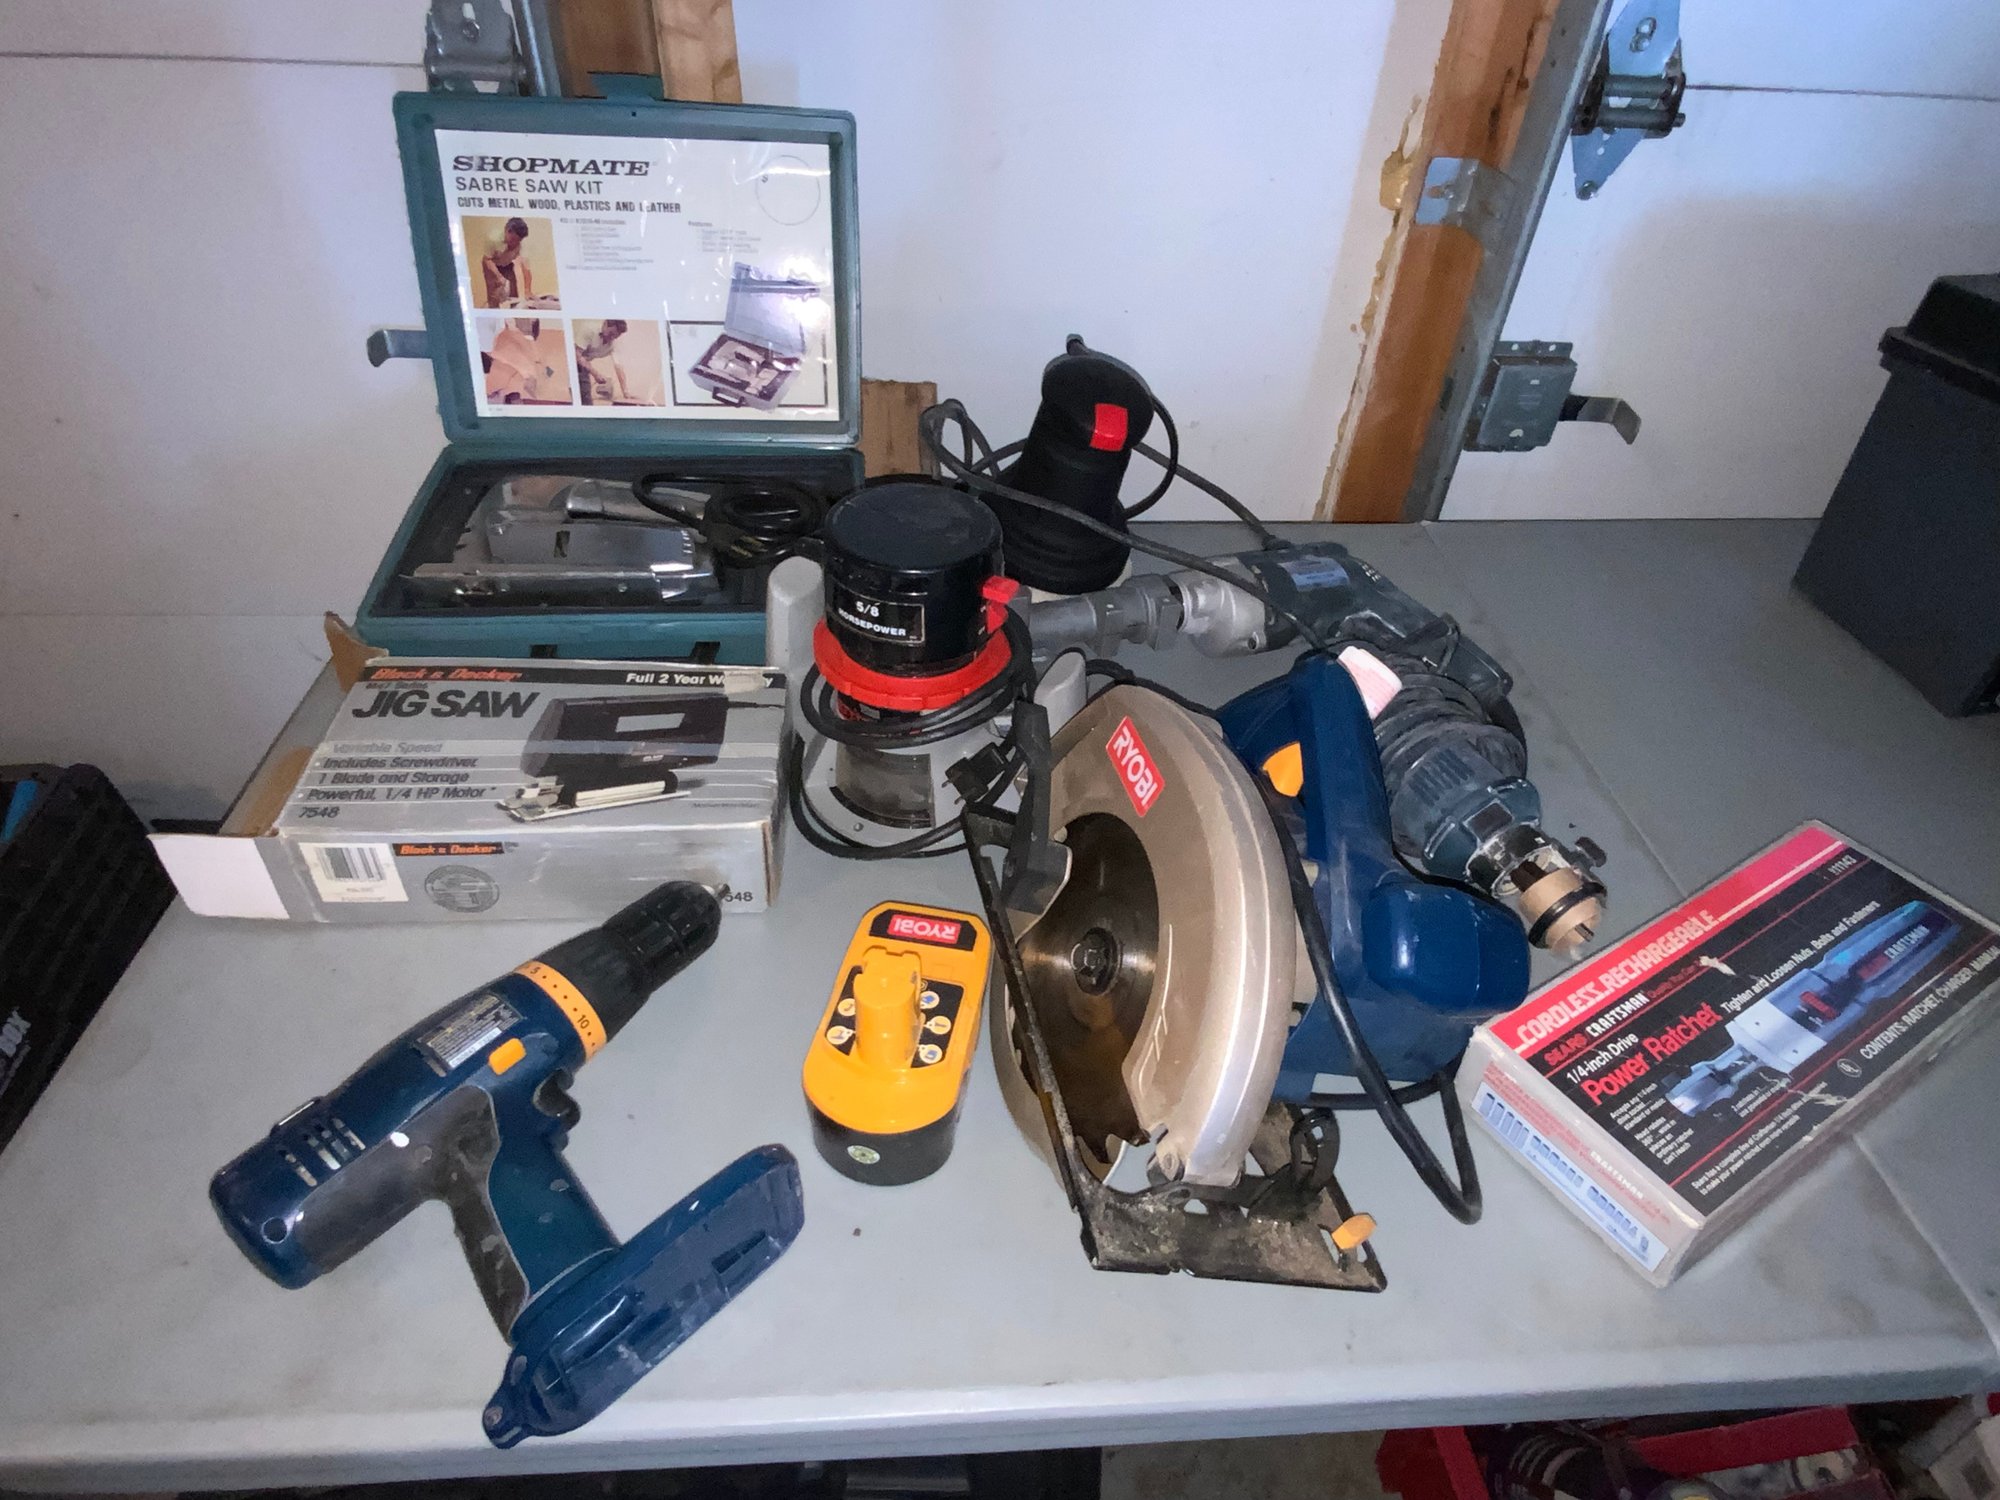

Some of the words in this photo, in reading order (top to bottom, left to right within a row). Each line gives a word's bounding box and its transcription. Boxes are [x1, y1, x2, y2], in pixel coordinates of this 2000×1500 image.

[452, 155, 650, 176] SHOPMATE
[455, 177, 519, 193] SABRE
[525, 179, 568, 193] SAW
[575, 181, 603, 194] KIT
[457, 197, 484, 208] CUTS
[528, 199, 560, 210] WOOD,
[564, 201, 611, 211] PLASTICS
[615, 202, 635, 212] AND
[639, 202, 681, 213] LATHER
[856, 601, 880, 617] 5/8
[838, 607, 906, 636] HORSEPOWER
[371, 668, 427, 679] Black
[448, 668, 522, 680] Decker
[626, 673, 654, 684] Full
[658, 674, 669, 684] 2
[674, 674, 705, 685] Year
[352, 690, 430, 718] JIG
[430, 690, 540, 718] SAW
[398, 743, 443, 755] Speed
[323, 758, 387, 769] Includes
[1113, 725, 1158, 806] RYOBI
[331, 773, 374, 784] Blade
[377, 773, 408, 784] and
[411, 772, 469, 786] Storage
[385, 788, 411, 800] 1/4
[416, 788, 439, 799] HP
[442, 787, 486, 798] Motor
[298, 806, 340, 818] 7548
[400, 845, 435, 855] Black
[450, 844, 497, 854] Decker
[724, 890, 753, 902] 548
[893, 917, 957, 940] RYOBI
[1720, 990, 1754, 1012] Tighten
[1749, 978, 1770, 993] and
[1763, 959, 1796, 981] Loosen
[1790, 947, 1816, 962] Nuts,
[1809, 932, 1835, 948] Bolts
[1828, 923, 1848, 935] and
[1841, 901, 1880, 925] Fasteners
[529, 966, 541, 975] 5
[1514, 982, 1606, 1046] CORDLESS
[1598, 909, 1719, 991] RECHARGEABLE
[1585, 993, 1650, 1036] CRAFTSMAN
[1859, 1020, 1907, 1059] CONTENTS:
[1901, 994, 1943, 1025] RATCHET,
[1935, 966, 1975, 997] CHARGER,
[578, 1014, 590, 1030] 10
[1565, 1050, 1612, 1084] 1/4-inch
[1606, 1033, 1639, 1055] Drive
[1580, 1052, 1651, 1105] Power
[1639, 1001, 1722, 1061] Ratchet
[1609, 1102, 1631, 1117] Accepts
[1628, 1096, 1639, 1104] any
[1617, 1114, 1630, 1124] drive
[1624, 1113, 1646, 1130] standard
[1635, 1128, 1649, 1140] Head
[1647, 1116, 1665, 1130] rotates
[1656, 1141, 1677, 1157] ordinary
[1674, 1128, 1693, 1143] ratchet
[1675, 1142, 1690, 1154] reach
[1691, 1175, 1708, 1188] Sears
[1704, 1166, 1717, 1178] has
[1718, 1148, 1741, 1168] complete
[1738, 1142, 1749, 1151] line
[1751, 1121, 1776, 1139] Craftsman
[1705, 1178, 1720, 1189] make
[1719, 1169, 1730, 1181] your
[1729, 1158, 1744, 1172] power
[1742, 1145, 1761, 1160] ratchet
[1759, 1137, 1771, 1147] even
[1769, 1128, 1782, 1139] more
